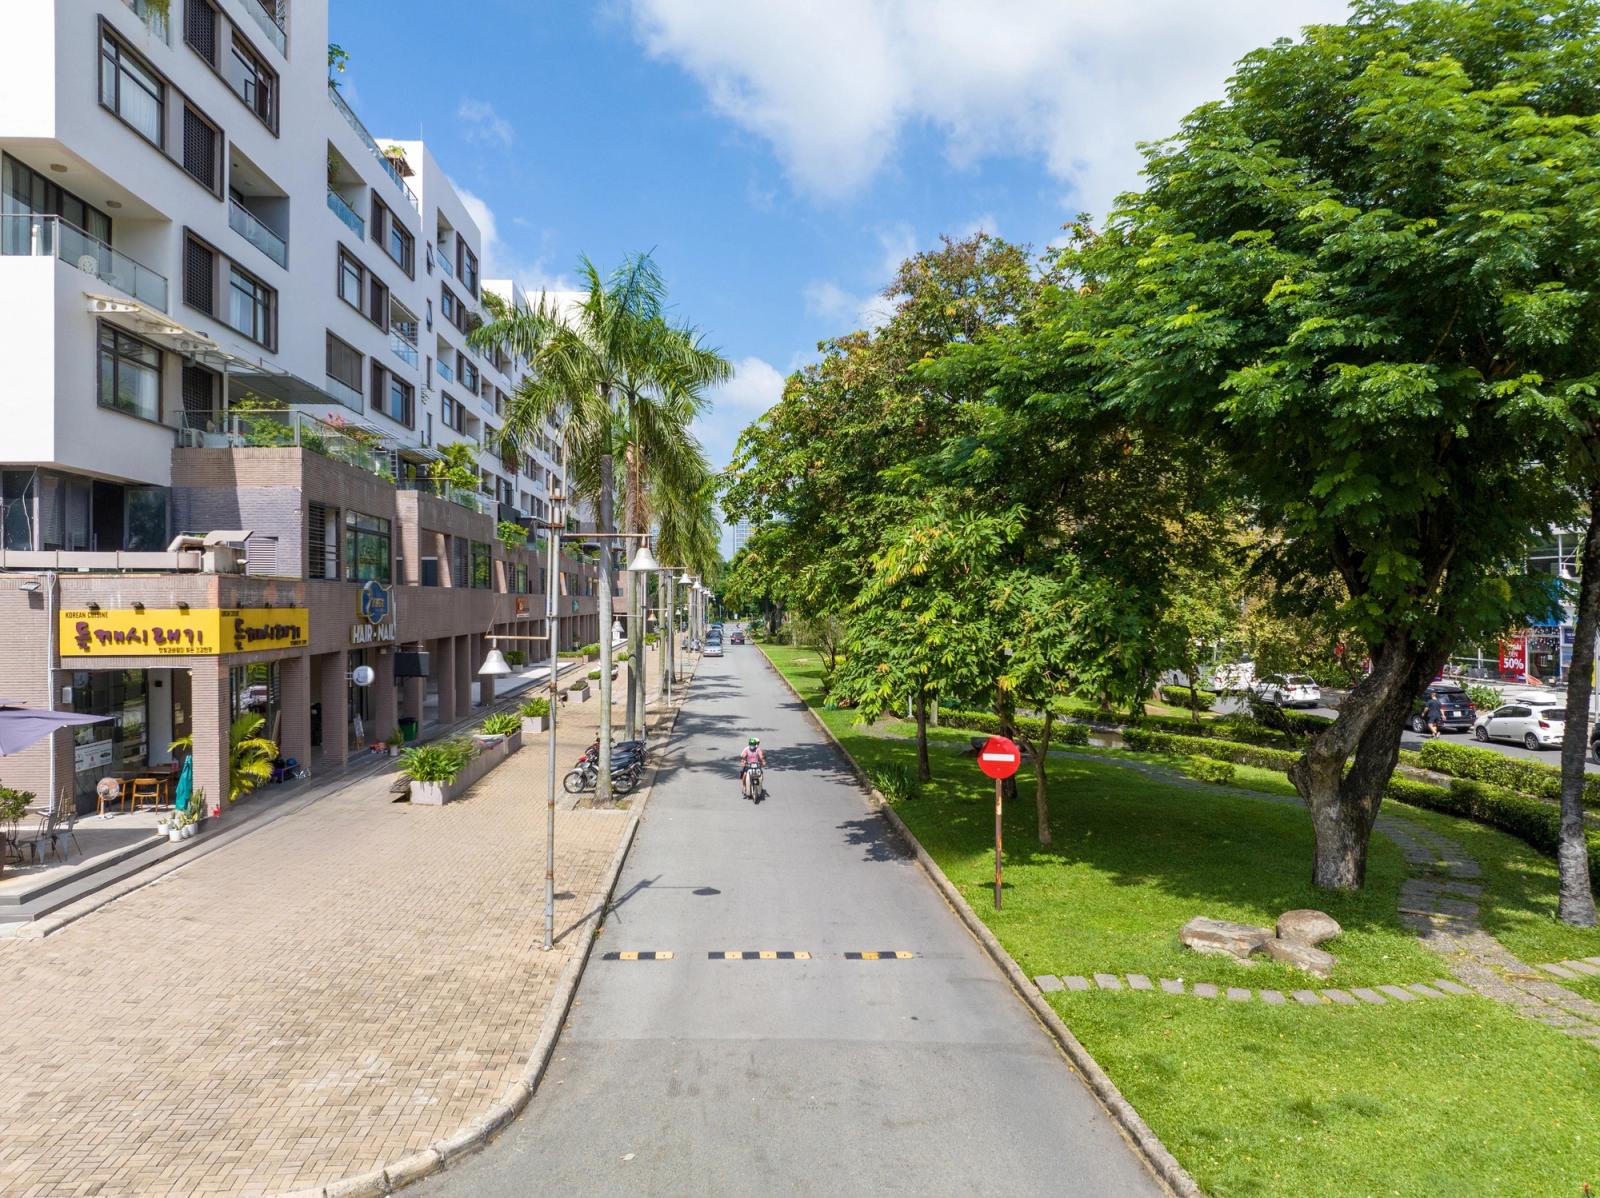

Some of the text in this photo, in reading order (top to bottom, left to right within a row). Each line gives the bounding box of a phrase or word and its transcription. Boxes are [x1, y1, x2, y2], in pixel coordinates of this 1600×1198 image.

[352, 624, 373, 643] HAIR
[377, 623, 395, 640] NAIL
[1503, 657, 1524, 670] 50%
